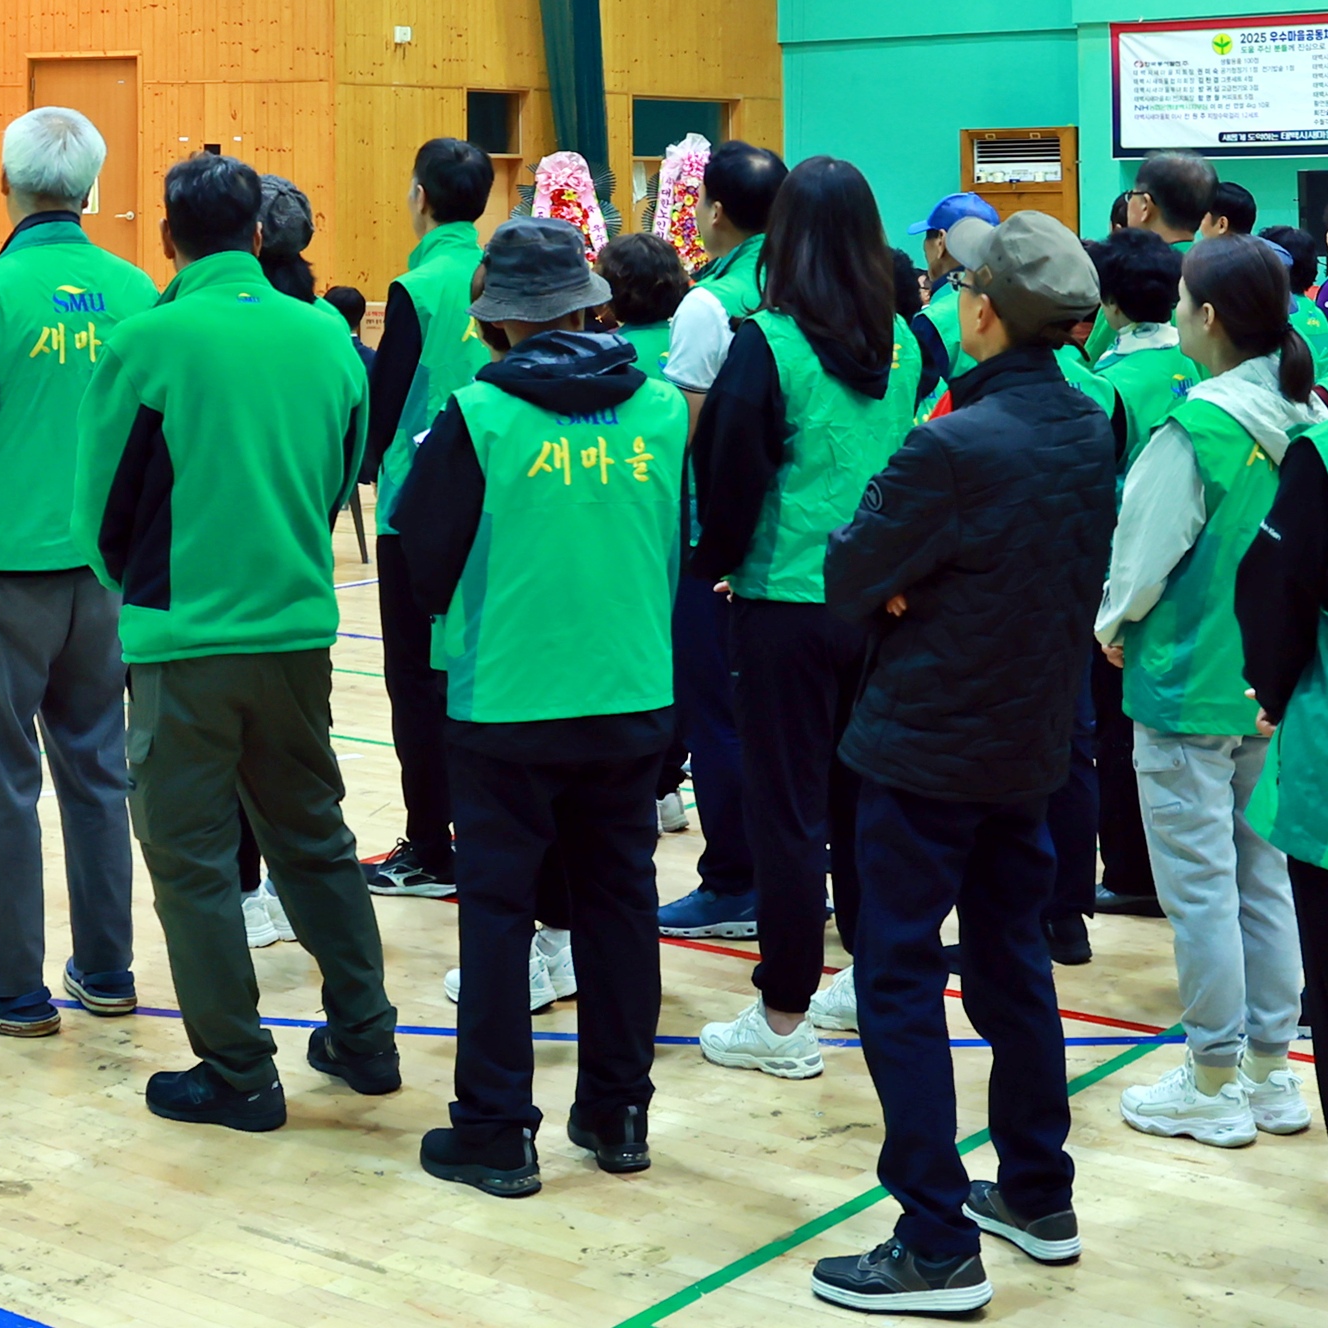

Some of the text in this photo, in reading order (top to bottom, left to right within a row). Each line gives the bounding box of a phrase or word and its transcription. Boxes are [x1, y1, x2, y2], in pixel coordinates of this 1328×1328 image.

[1240, 32, 1267, 44] 2025
[1257, 45, 1272, 53] 주신
[1297, 42, 1326, 52] 진심으로
[52, 291, 106, 315] SMU
[29, 321, 102, 364] 새마
[527, 435, 655, 485] 새마을
